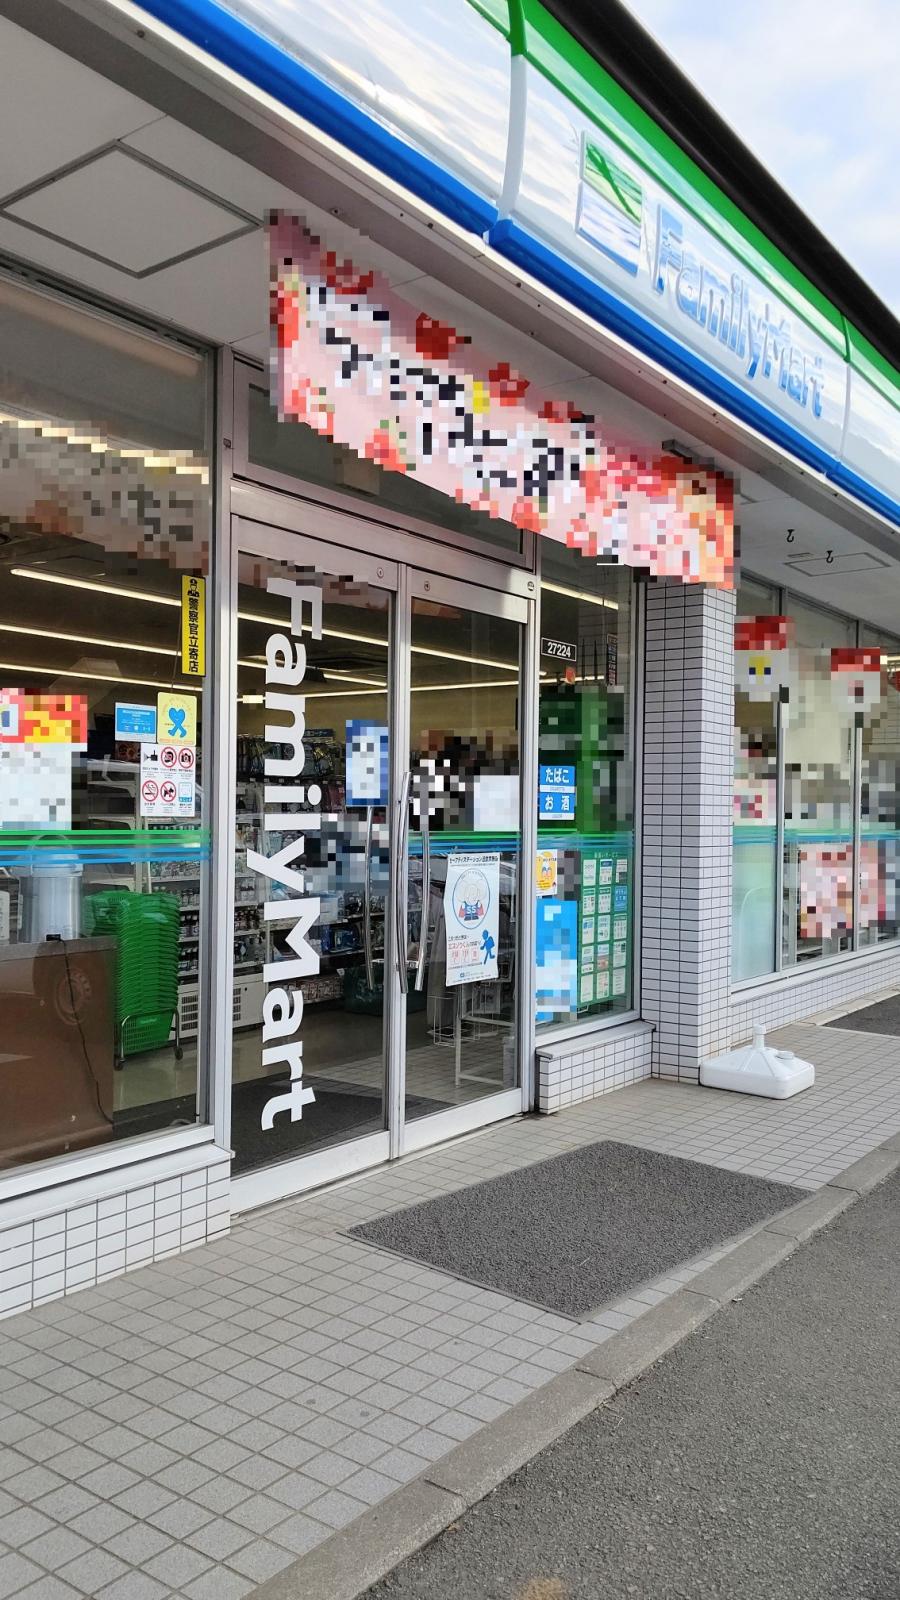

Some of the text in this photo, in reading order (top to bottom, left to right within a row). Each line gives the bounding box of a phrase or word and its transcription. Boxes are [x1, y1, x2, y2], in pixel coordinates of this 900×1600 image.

[653, 203, 824, 419] FamilyMart
[188, 597, 200, 674] 警察官立寄店
[547, 641, 572, 658] 27224
[545, 767, 570, 784] たばこ
[246, 577, 323, 1131] FamilyMart
